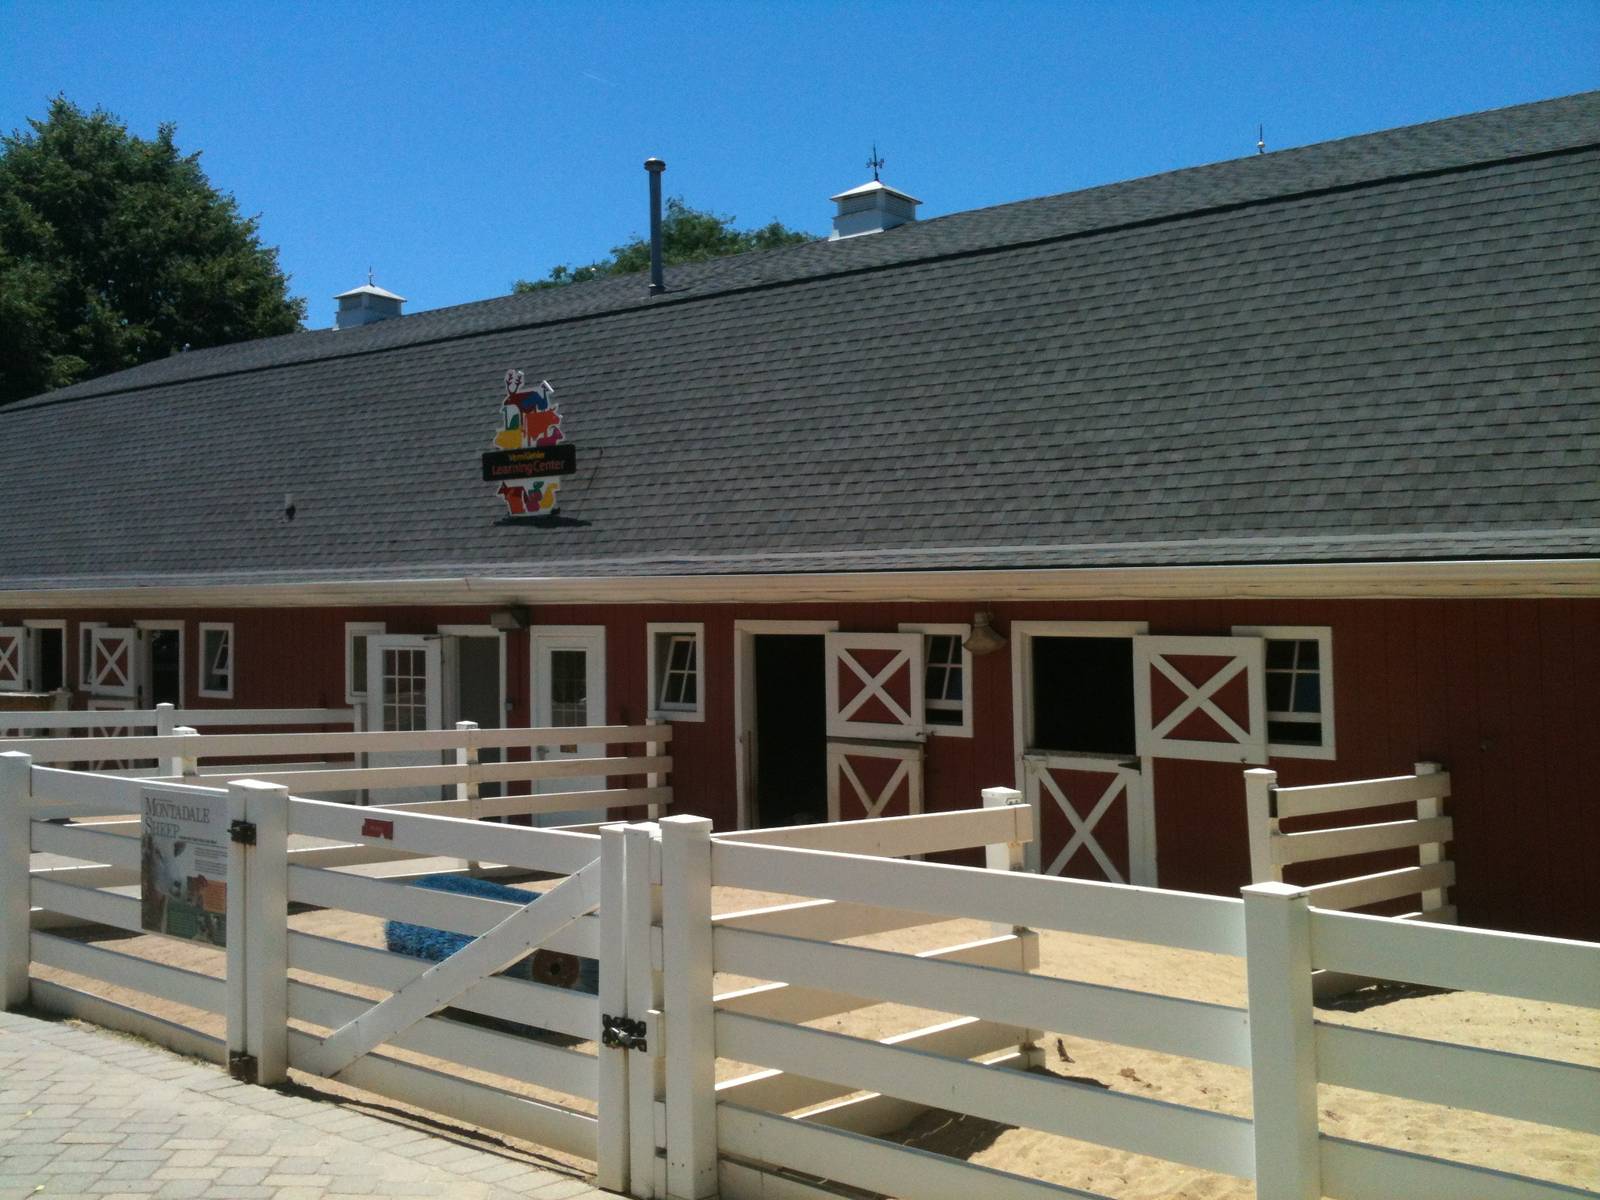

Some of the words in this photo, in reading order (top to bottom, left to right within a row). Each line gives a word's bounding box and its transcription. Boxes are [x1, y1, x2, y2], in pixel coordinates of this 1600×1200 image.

[491, 462, 533, 476] Learning
[534, 459, 566, 472] Center
[145, 816, 181, 839] SHEEP
